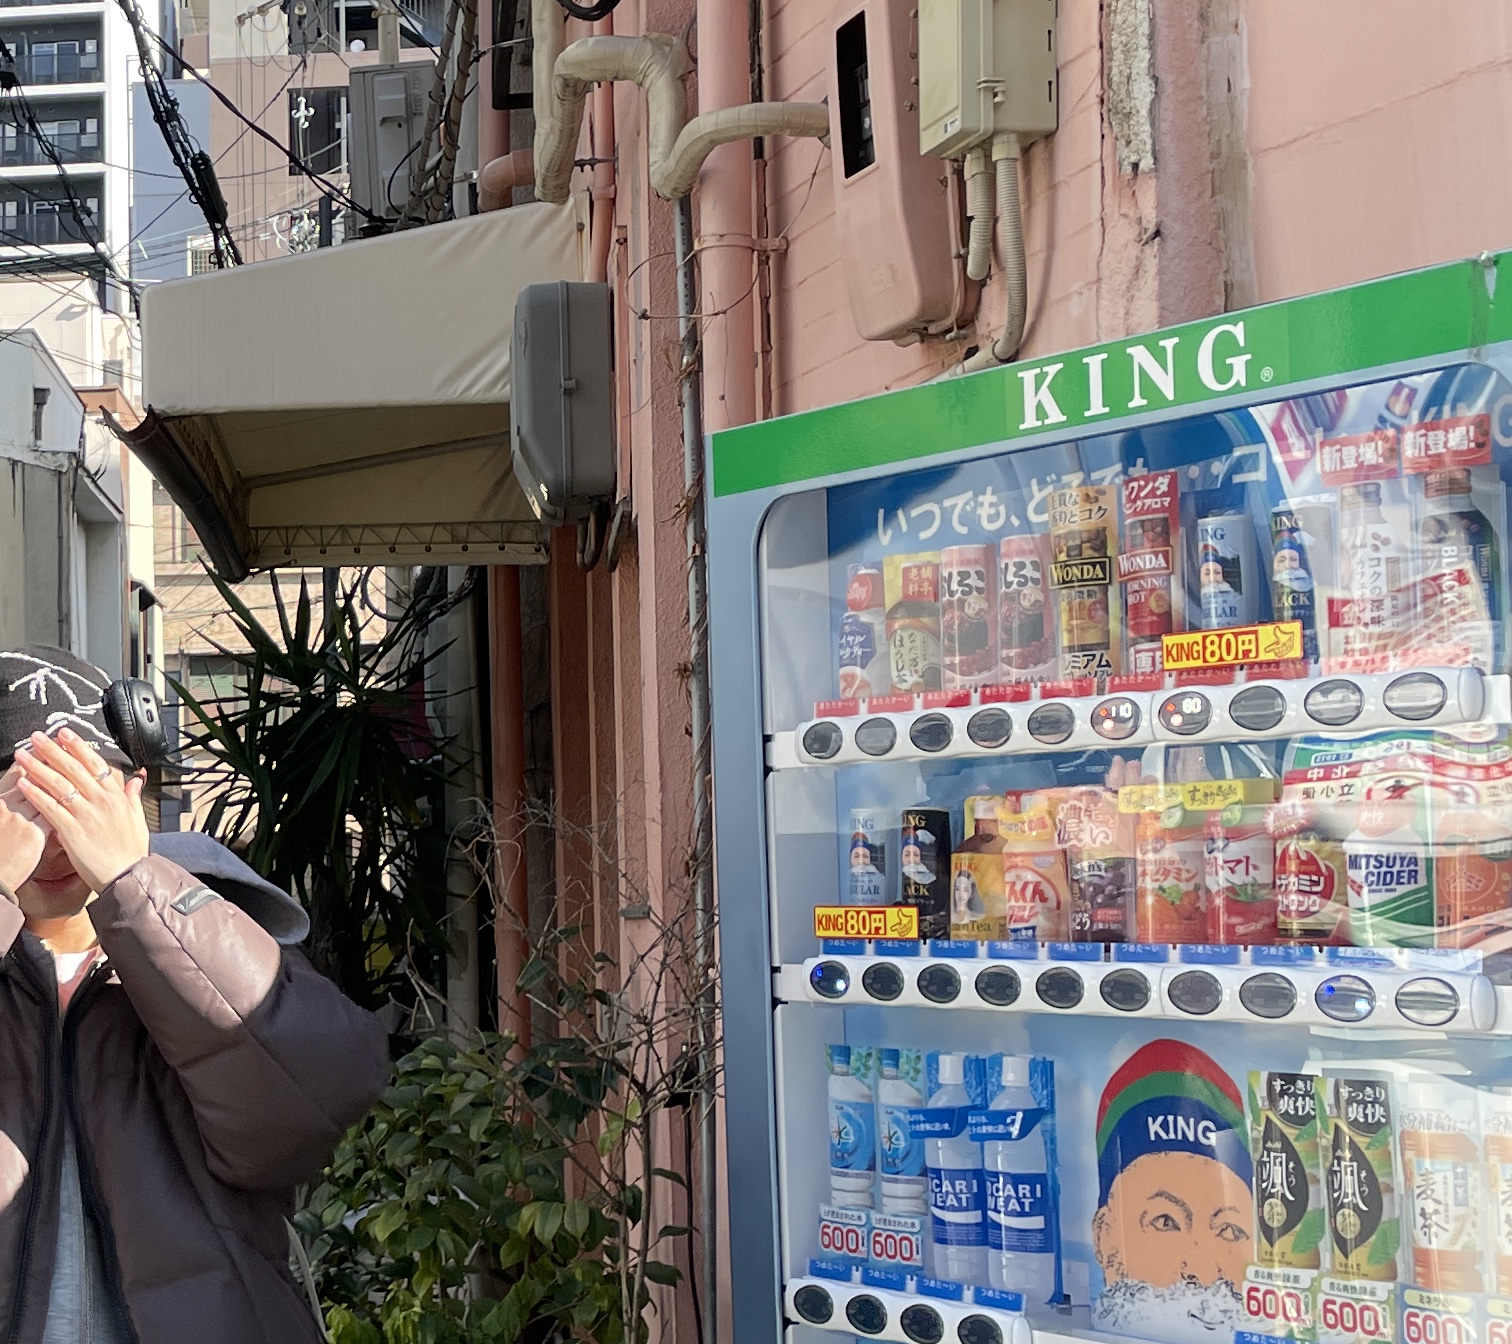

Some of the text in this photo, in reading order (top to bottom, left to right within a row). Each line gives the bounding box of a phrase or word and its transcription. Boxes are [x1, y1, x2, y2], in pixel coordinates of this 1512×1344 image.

[1017, 320, 1252, 430] KING
[1050, 562, 1105, 585] WONDA
[1117, 552, 1168, 576] WONDA
[1165, 633, 1257, 664] KING 80円
[1347, 852, 1419, 871] MITSUYA
[1364, 870, 1419, 886] CIDER
[817, 910, 886, 935] KING 80円
[1272, 1077, 1315, 1096] すっきり
[1340, 1085, 1386, 1101] すっきり
[1278, 1096, 1316, 1116] 爽快
[1347, 1103, 1386, 1123] 爽快
[1147, 1115, 1217, 1146] KING
[1416, 1167, 1450, 1246] 麦茶
